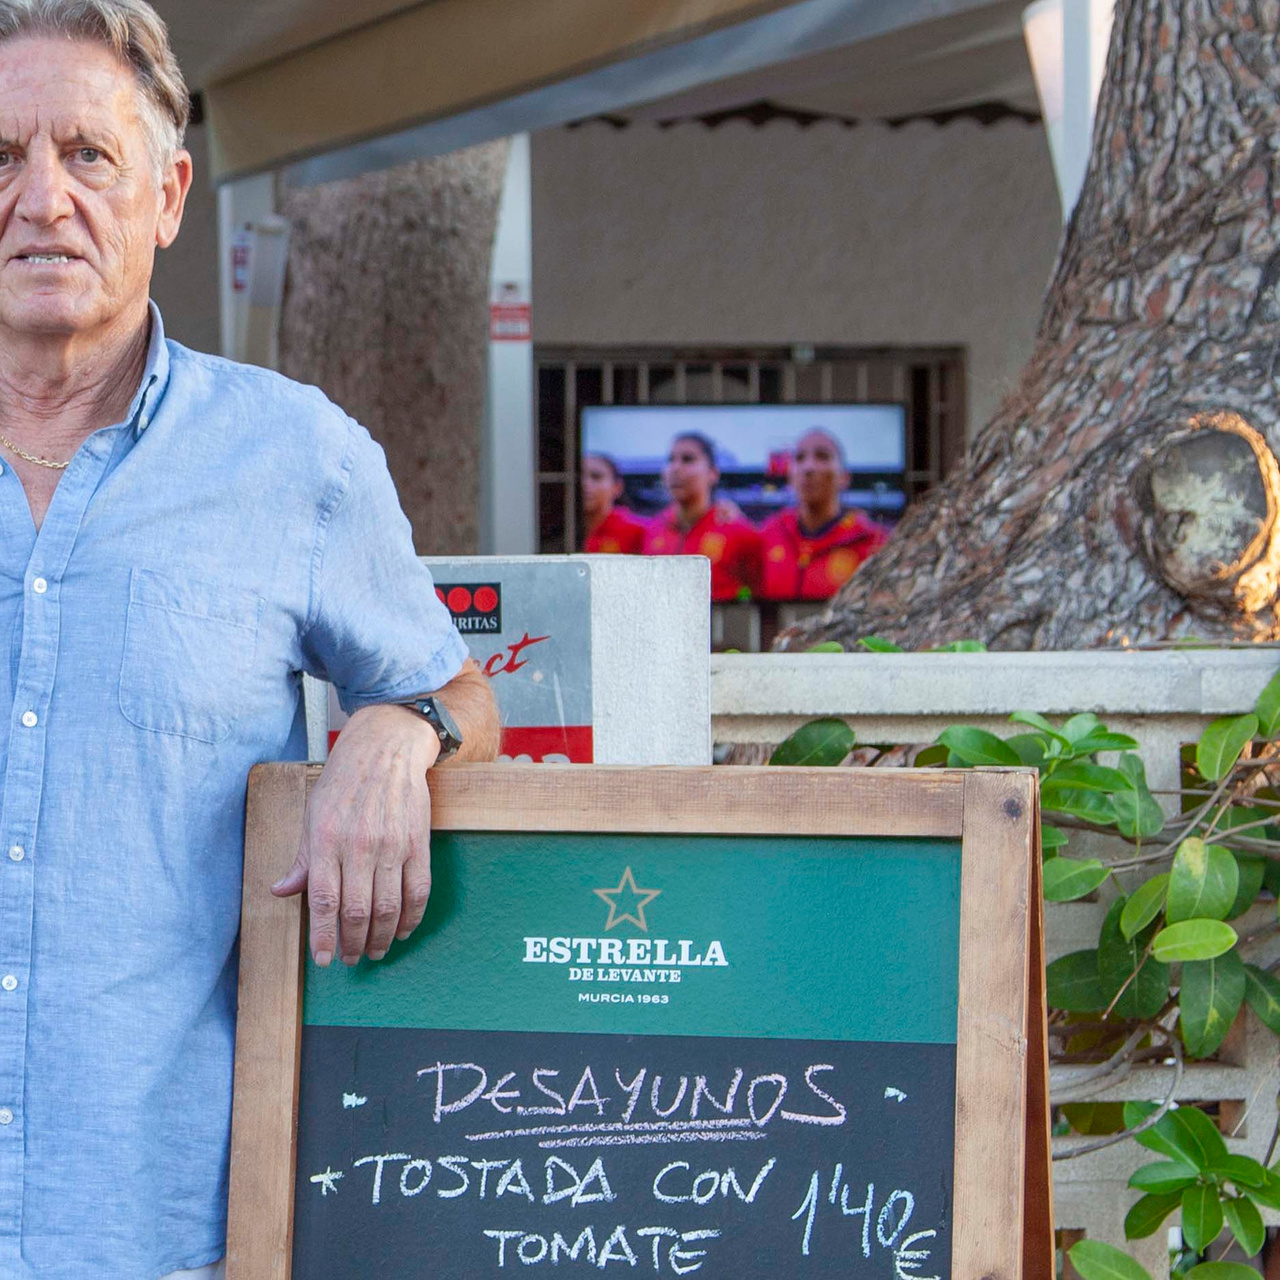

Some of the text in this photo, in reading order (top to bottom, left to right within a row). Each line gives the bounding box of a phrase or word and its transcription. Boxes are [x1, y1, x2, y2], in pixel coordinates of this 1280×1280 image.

[522, 936, 729, 967] ESTRELLA
[569, 968, 681, 983] DE LEVANTE
[578, 992, 669, 1004] MURCIA 1963
[354, 1152, 618, 1207] TOSTADA
[652, 1157, 778, 1205] CON
[484, 1224, 721, 1275] TOMATE
